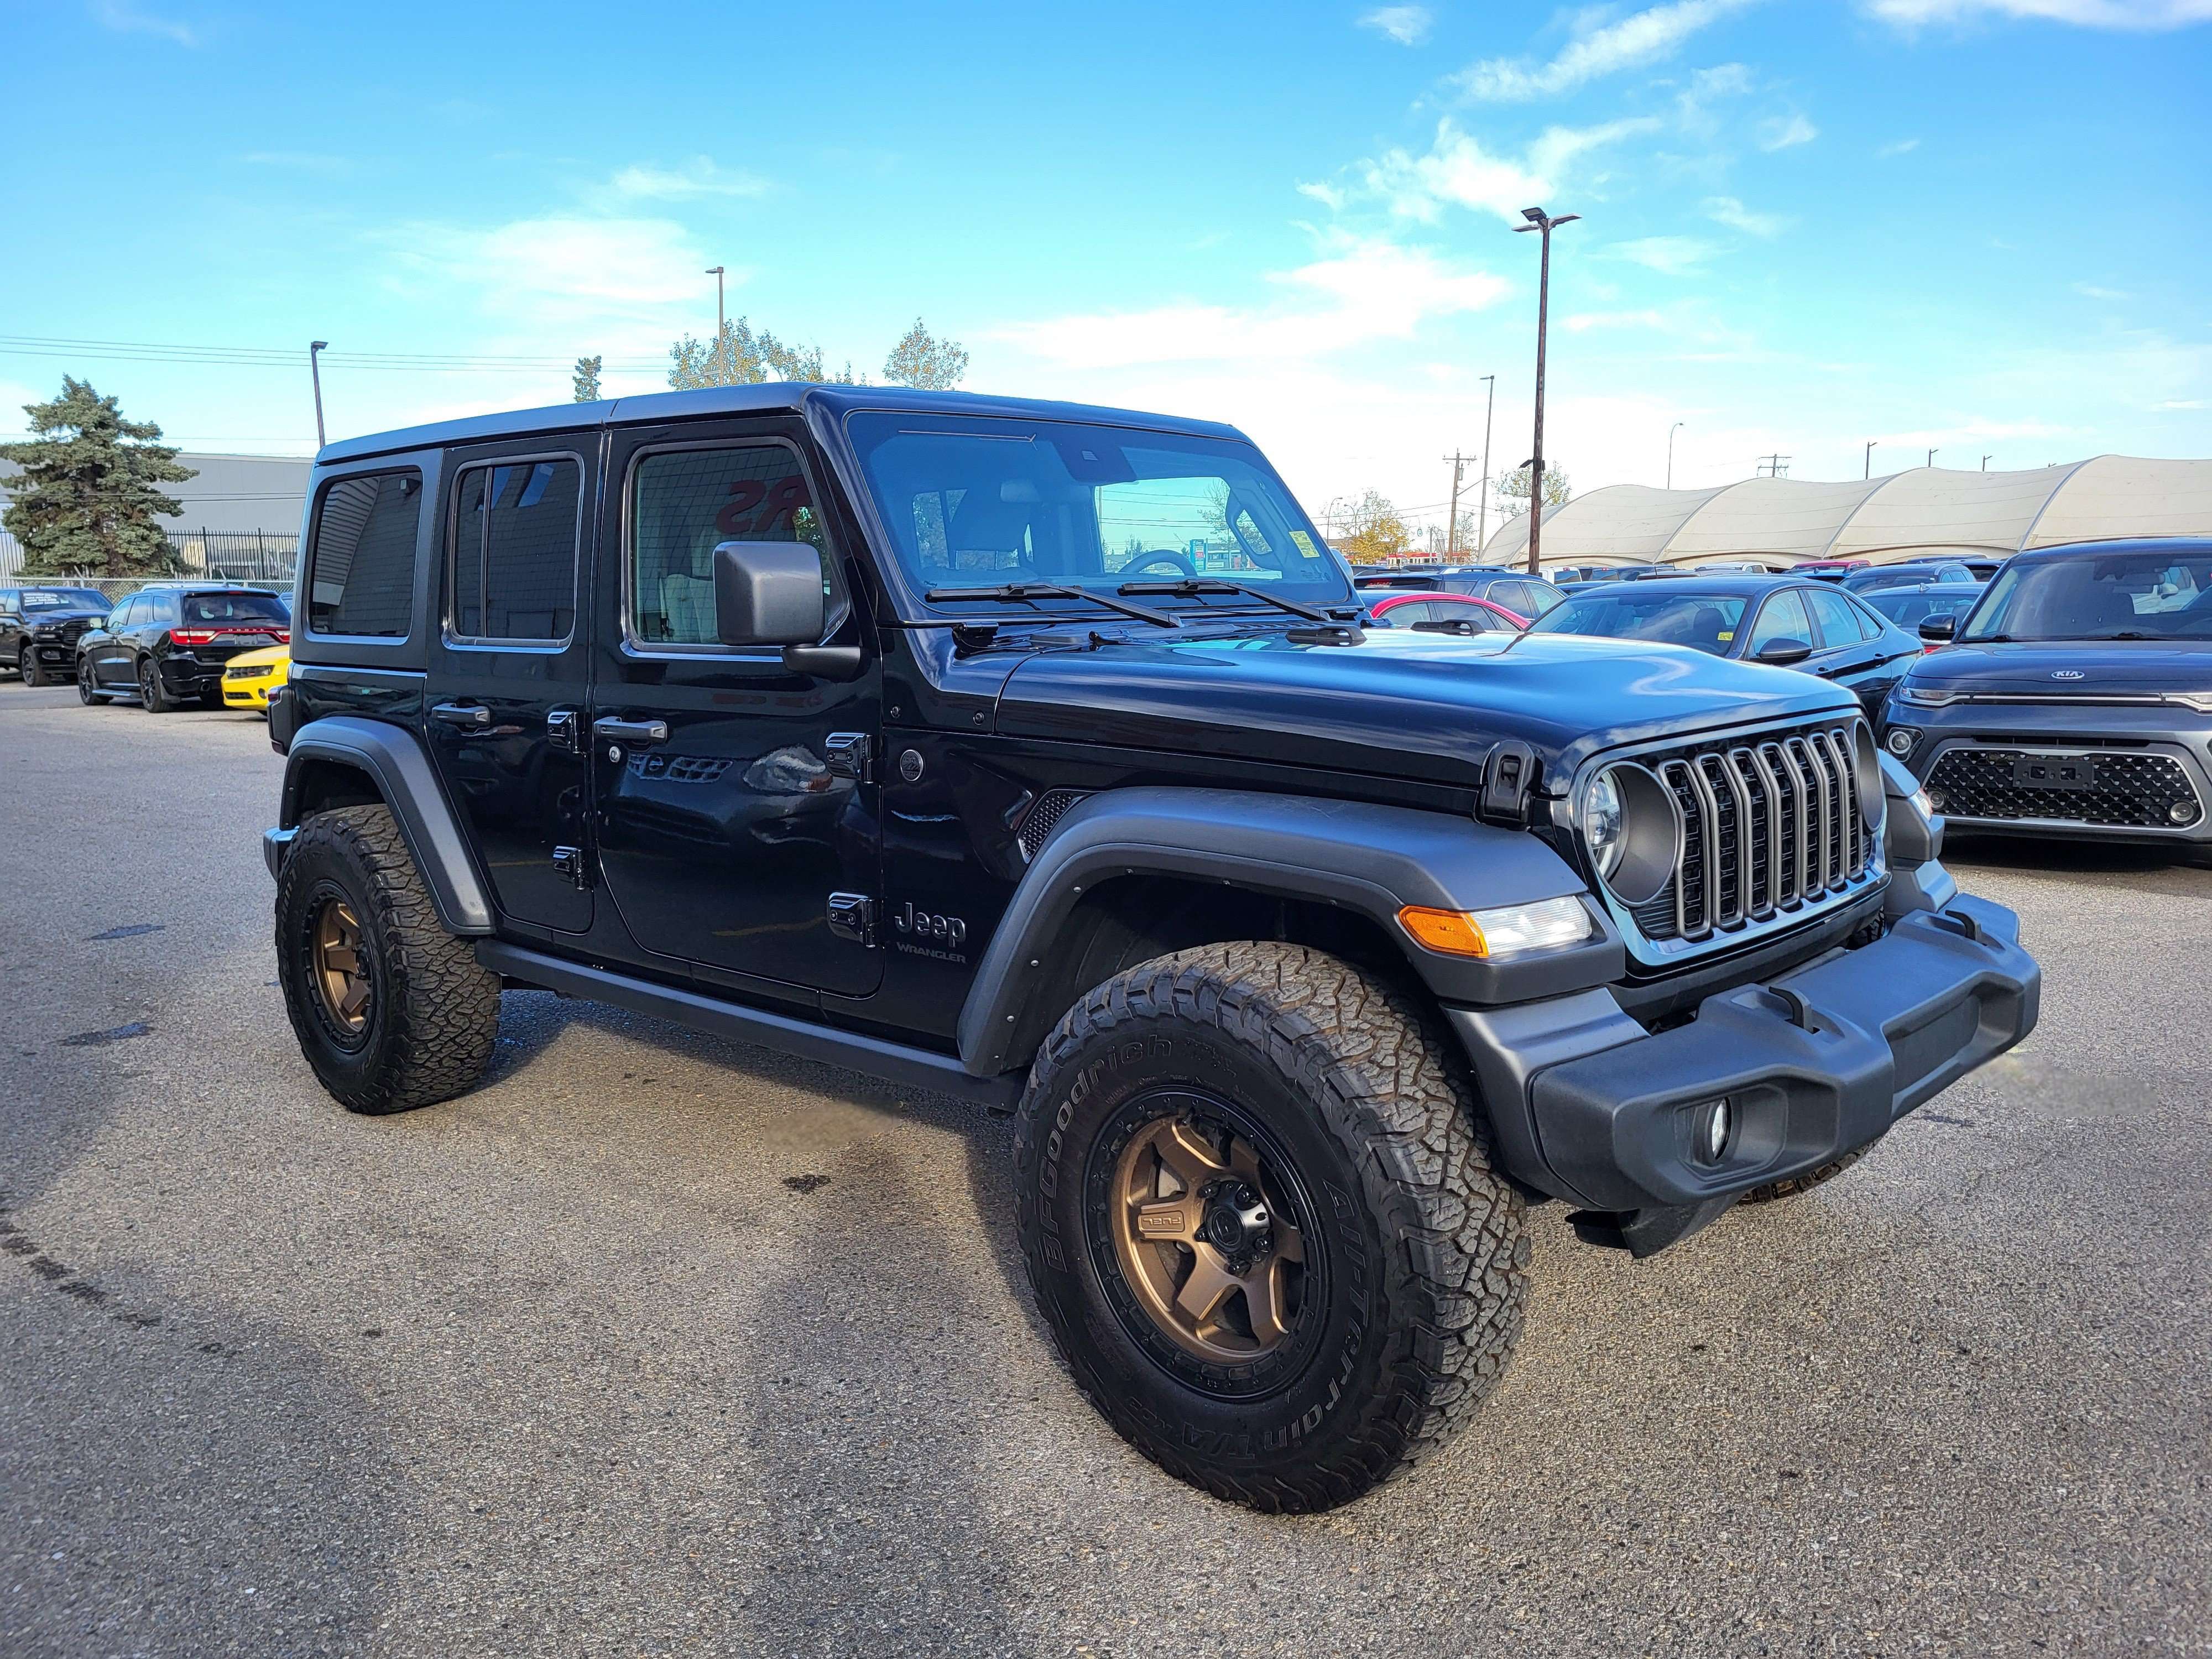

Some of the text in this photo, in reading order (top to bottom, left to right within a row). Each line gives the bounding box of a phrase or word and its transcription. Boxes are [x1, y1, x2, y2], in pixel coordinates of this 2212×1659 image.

[894, 902, 966, 948] Jeep
[895, 942, 966, 964] WRANGLER
[1036, 1033, 1172, 1274] BFGoodrich
[1142, 1216, 1182, 1226] FUEL
[1263, 1177, 1369, 1451] All-Terrain
